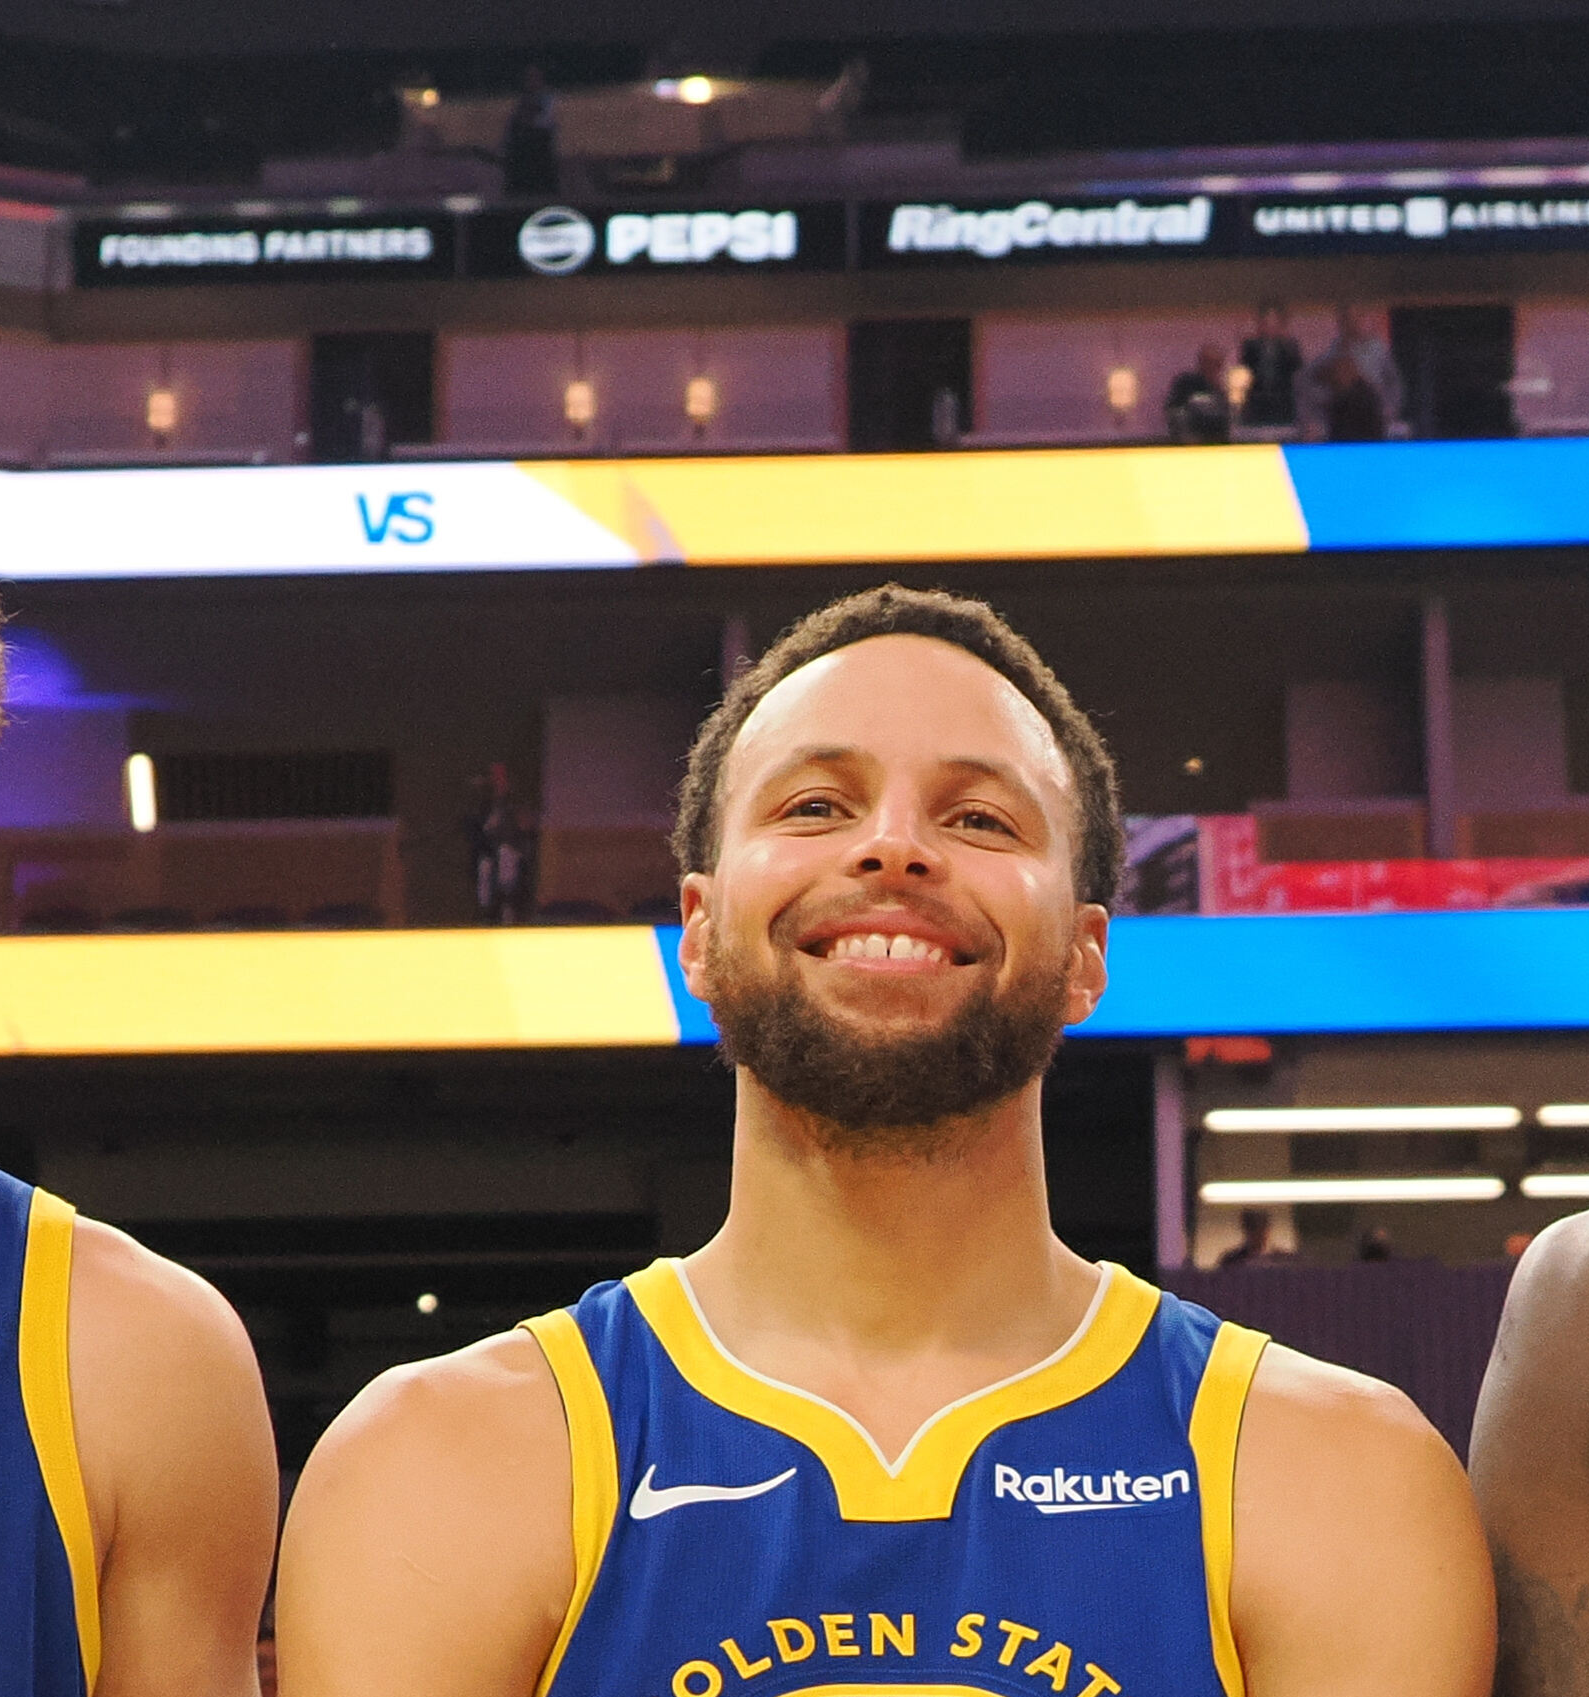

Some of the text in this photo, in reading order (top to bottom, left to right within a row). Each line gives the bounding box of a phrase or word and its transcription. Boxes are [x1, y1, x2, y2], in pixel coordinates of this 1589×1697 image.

[264, 227, 431, 261] PARTNERS
[605, 210, 797, 263] PEPSI
[888, 196, 1211, 257] RingCentral
[1255, 204, 1400, 234] UNITED
[356, 491, 435, 543] VS
[993, 1462, 1191, 1516] Rakuten
